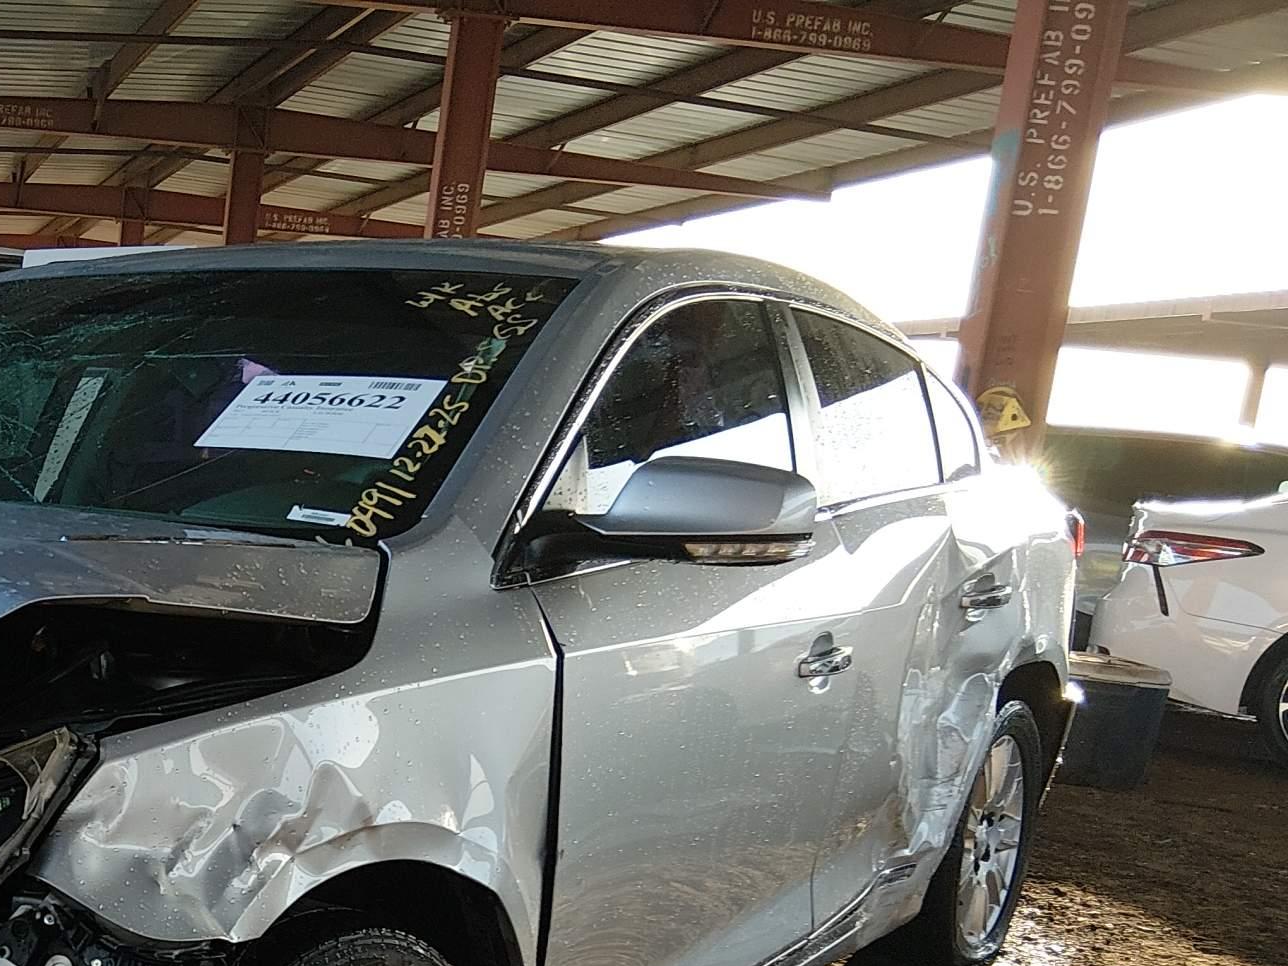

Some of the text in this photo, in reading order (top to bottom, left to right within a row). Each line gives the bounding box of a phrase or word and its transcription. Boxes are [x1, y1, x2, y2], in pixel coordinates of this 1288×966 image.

[751, 26, 872, 52] 1-866-799-0969
[752, 9, 873, 36] U.S. PREFAB INC.
[1025, 29, 1064, 144] PREFAB
[1013, 163, 1041, 216] U.S.
[252, 390, 407, 410] 44056622
[346, 481, 417, 537] 0491
